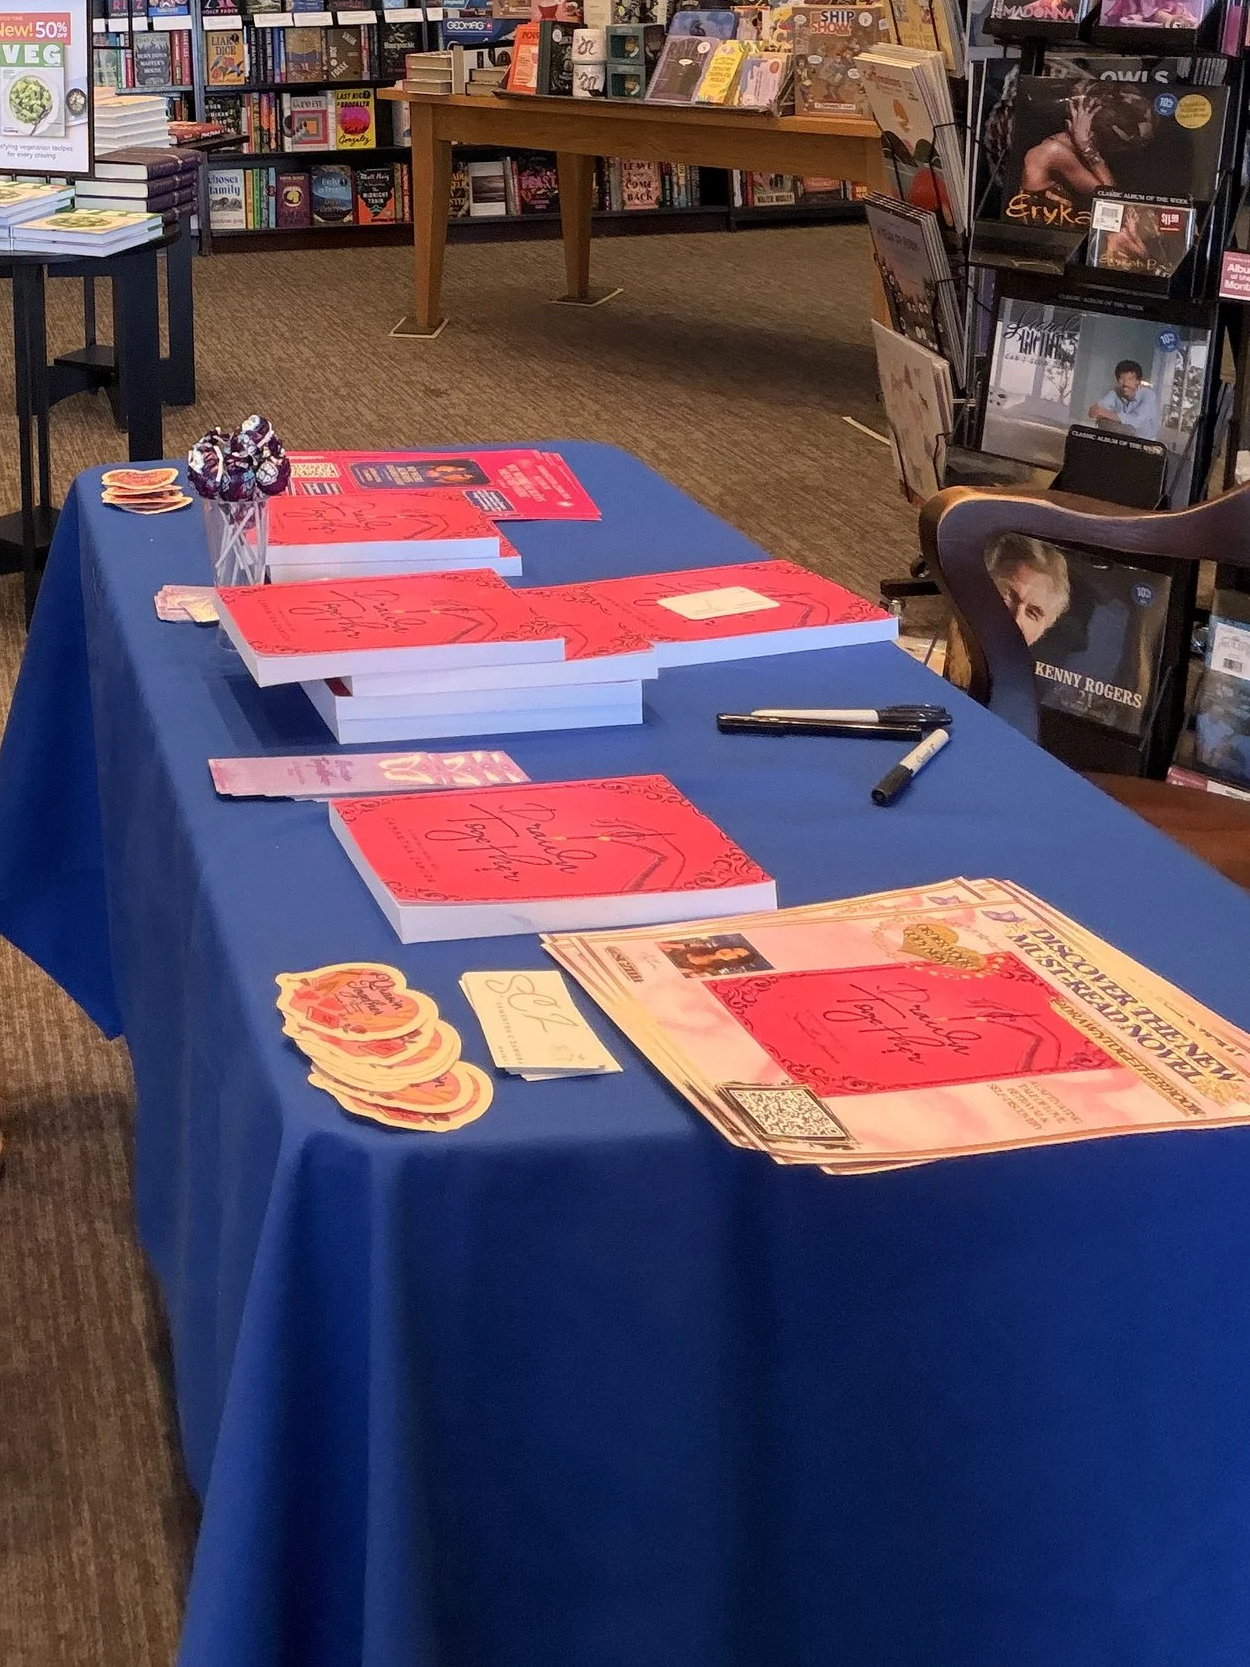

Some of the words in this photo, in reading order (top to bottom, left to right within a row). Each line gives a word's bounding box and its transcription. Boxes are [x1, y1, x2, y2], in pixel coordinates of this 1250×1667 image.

[821, 10, 855, 22] SHIP
[1003, 5, 1075, 20] MADONNA
[35, 21, 68, 38] 50%
[447, 21, 485, 30] GEOMAG
[2, 44, 62, 65] VEG
[215, 46, 237, 55] DICE
[337, 92, 349, 100] LAST
[627, 193, 653, 201] BACK
[1097, 190, 1122, 199] CLASSIC
[1124, 192, 1145, 201] ALBUM
[1170, 197, 1189, 205] WEEK
[1006, 193, 1093, 226] Eryka
[1071, 430, 1096, 441] CLASSIC
[1097, 435, 1118, 445] ALBUM
[1129, 441, 1142, 449] THE
[1143, 444, 1163, 455] WEEK
[1035, 661, 1082, 686] KENNY
[1084, 676, 1143, 709] ROGERS
[1008, 933, 1131, 1031] MUST-READ
[1125, 1024, 1207, 1084] NOVEL
[1030, 927, 1138, 1006] DISCOVER
[1131, 1005, 1182, 1042] THE
[1179, 1041, 1245, 1085] NEW
